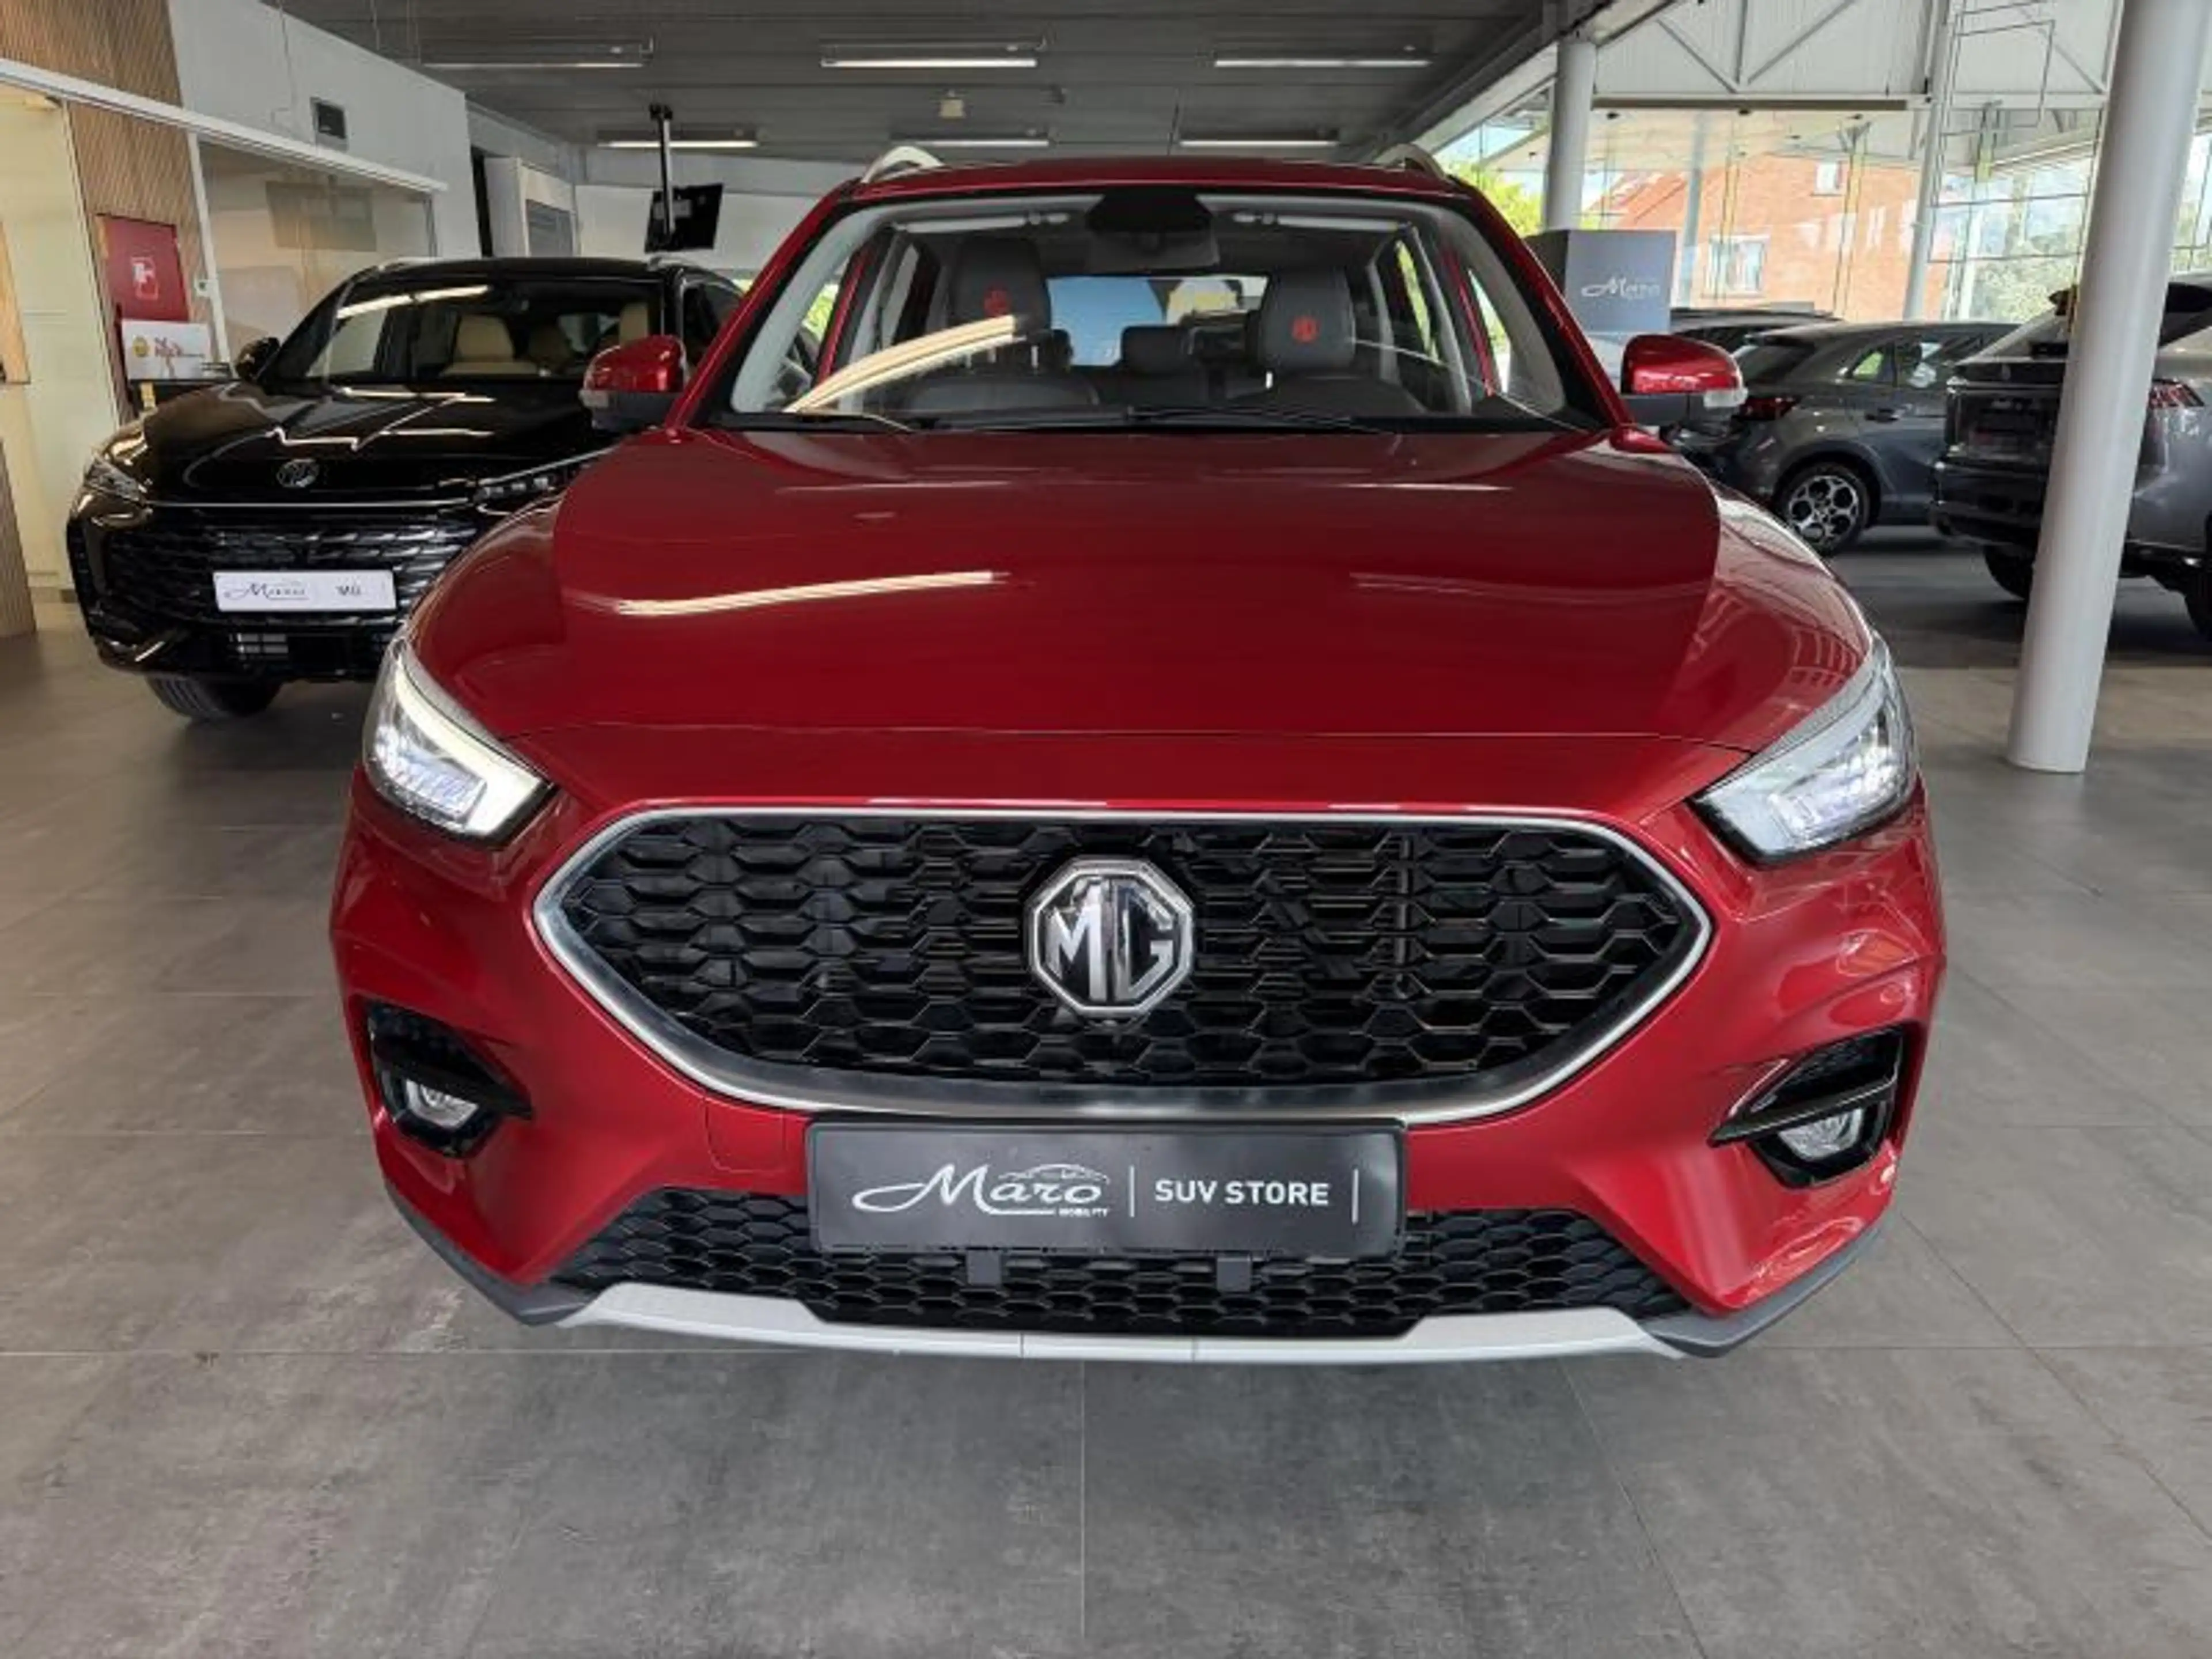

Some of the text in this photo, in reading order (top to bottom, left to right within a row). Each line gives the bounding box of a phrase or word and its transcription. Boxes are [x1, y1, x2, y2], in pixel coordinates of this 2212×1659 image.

[1045, 876, 1174, 1003] MG
[852, 1162, 1103, 1215] Maro
[1154, 1178, 1330, 1206] SUV STORE
